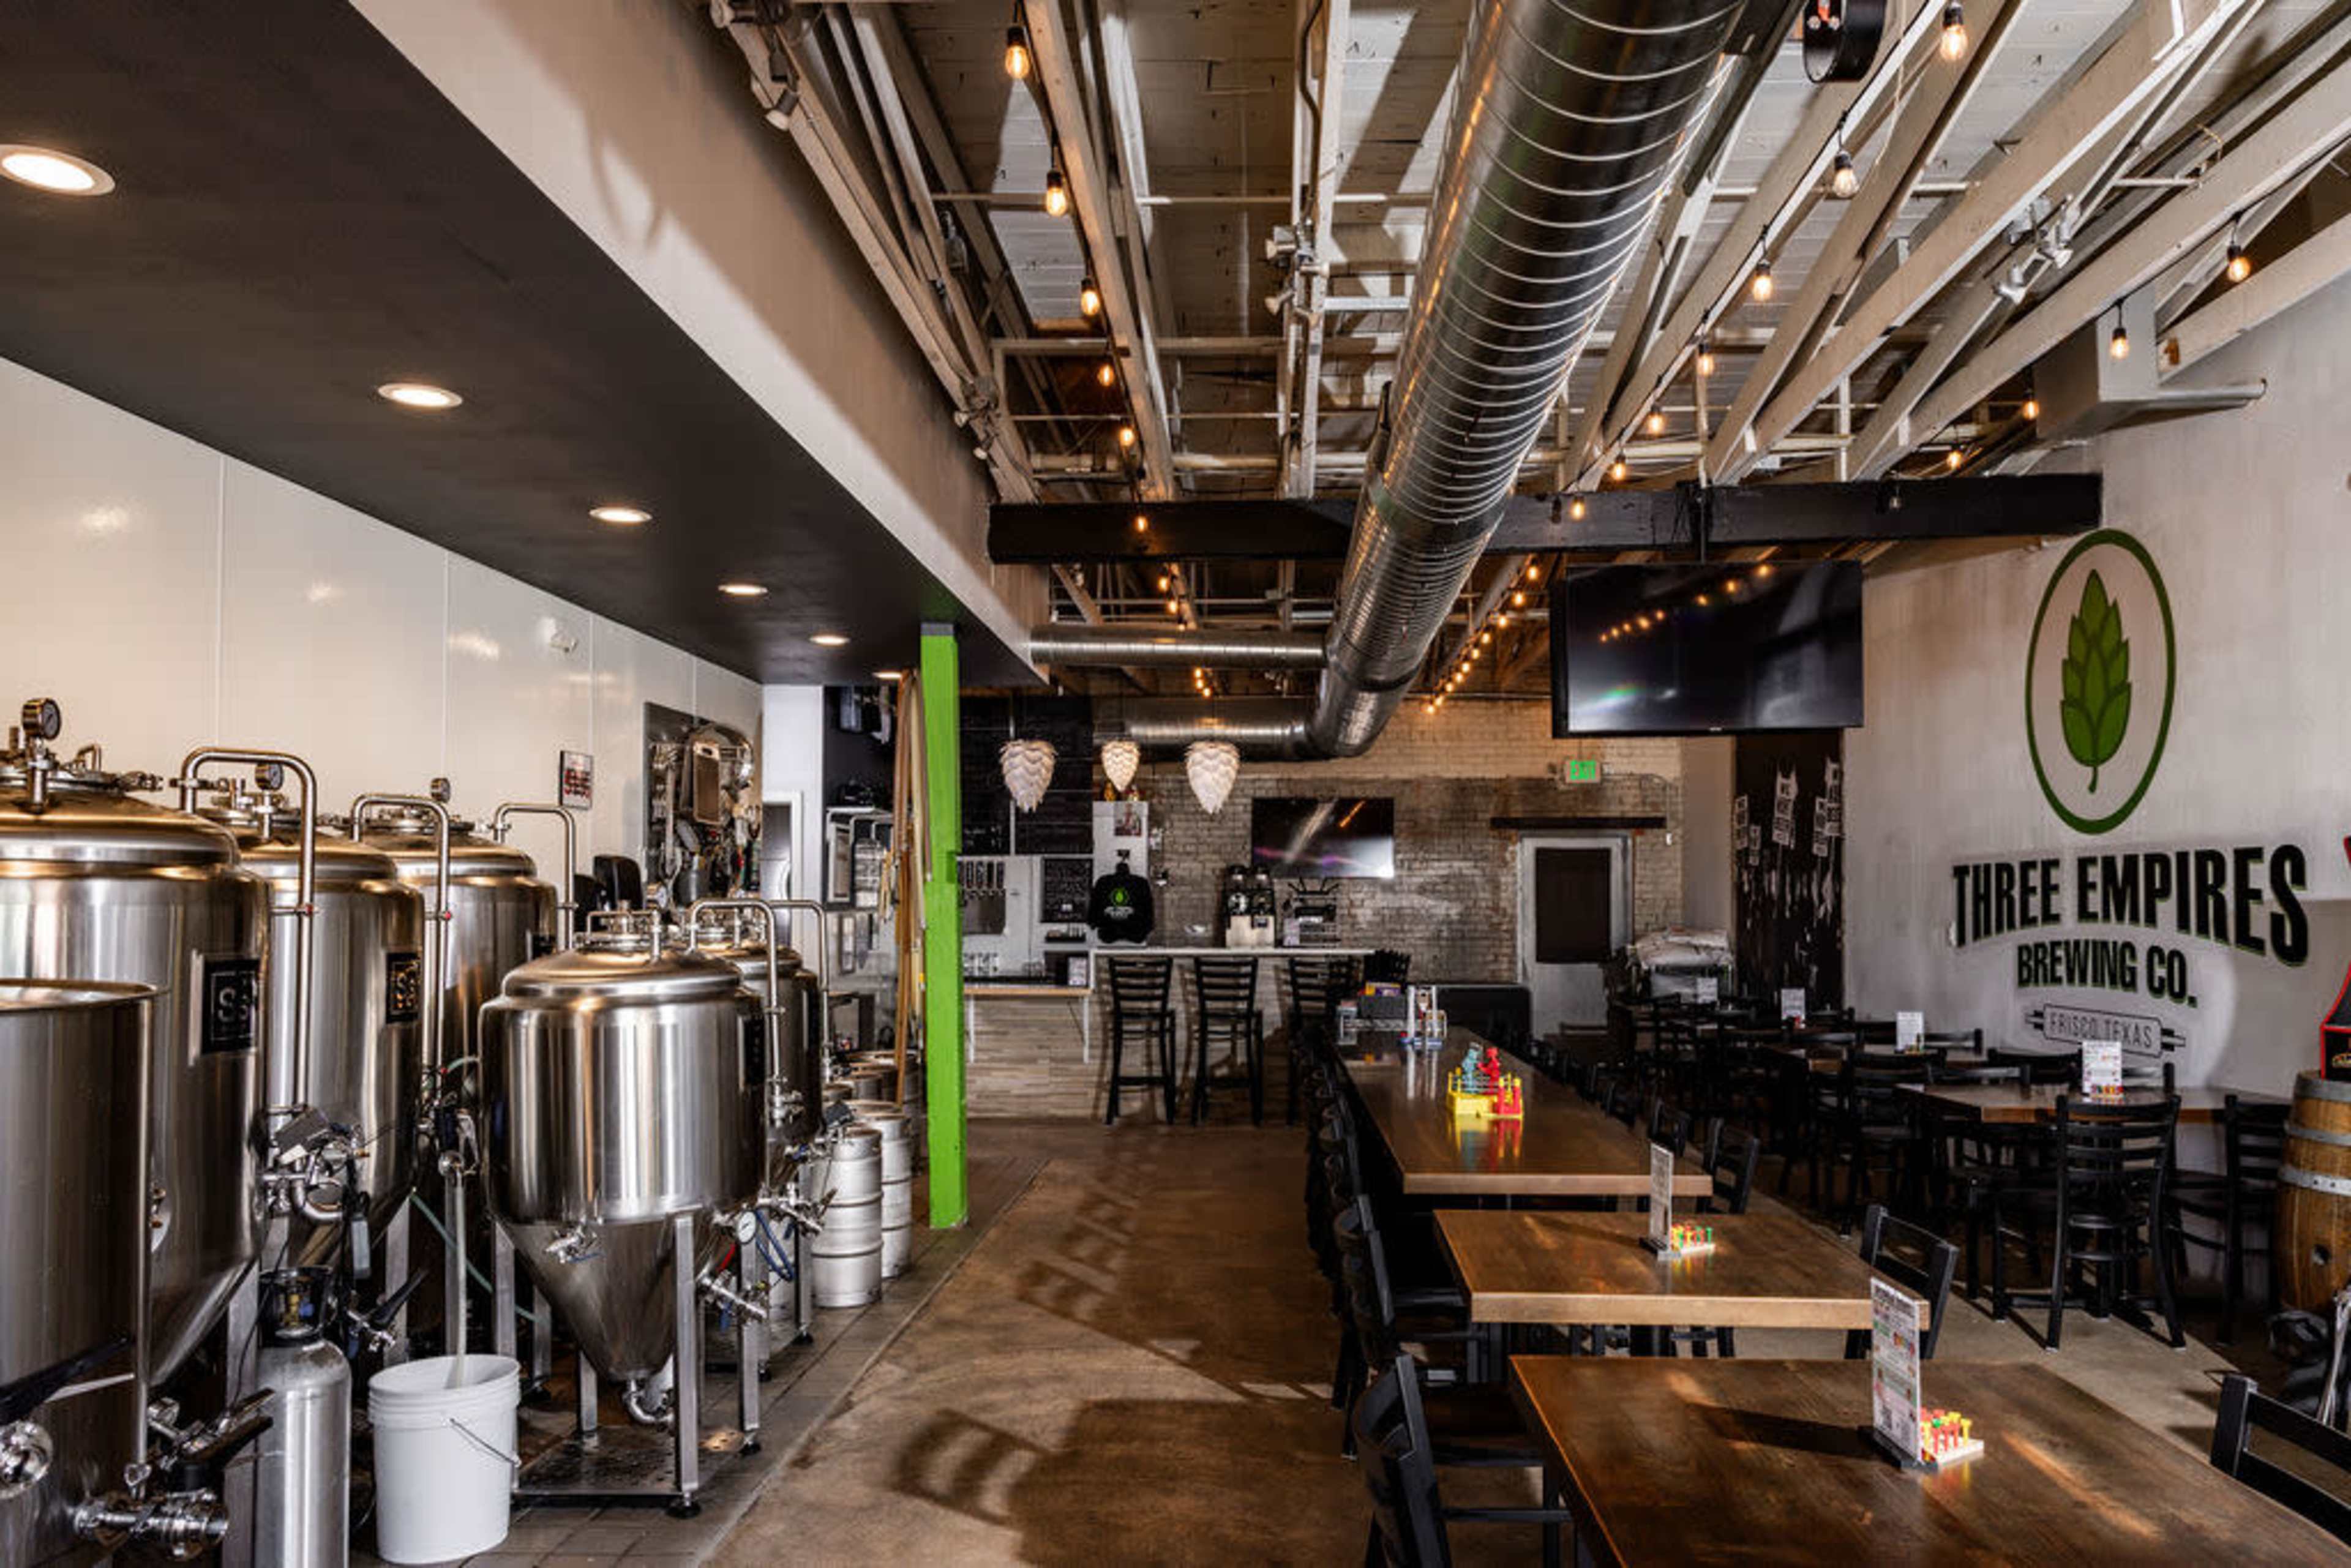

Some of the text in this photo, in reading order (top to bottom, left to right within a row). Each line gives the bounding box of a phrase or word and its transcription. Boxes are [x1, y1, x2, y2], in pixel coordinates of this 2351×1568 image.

[1570, 759, 1597, 780] EXIT
[1952, 844, 2308, 967] THREE EMPIRES
[2017, 939, 2198, 1008] BREWING CO.
[2103, 1018, 2152, 1048] TEXAS
